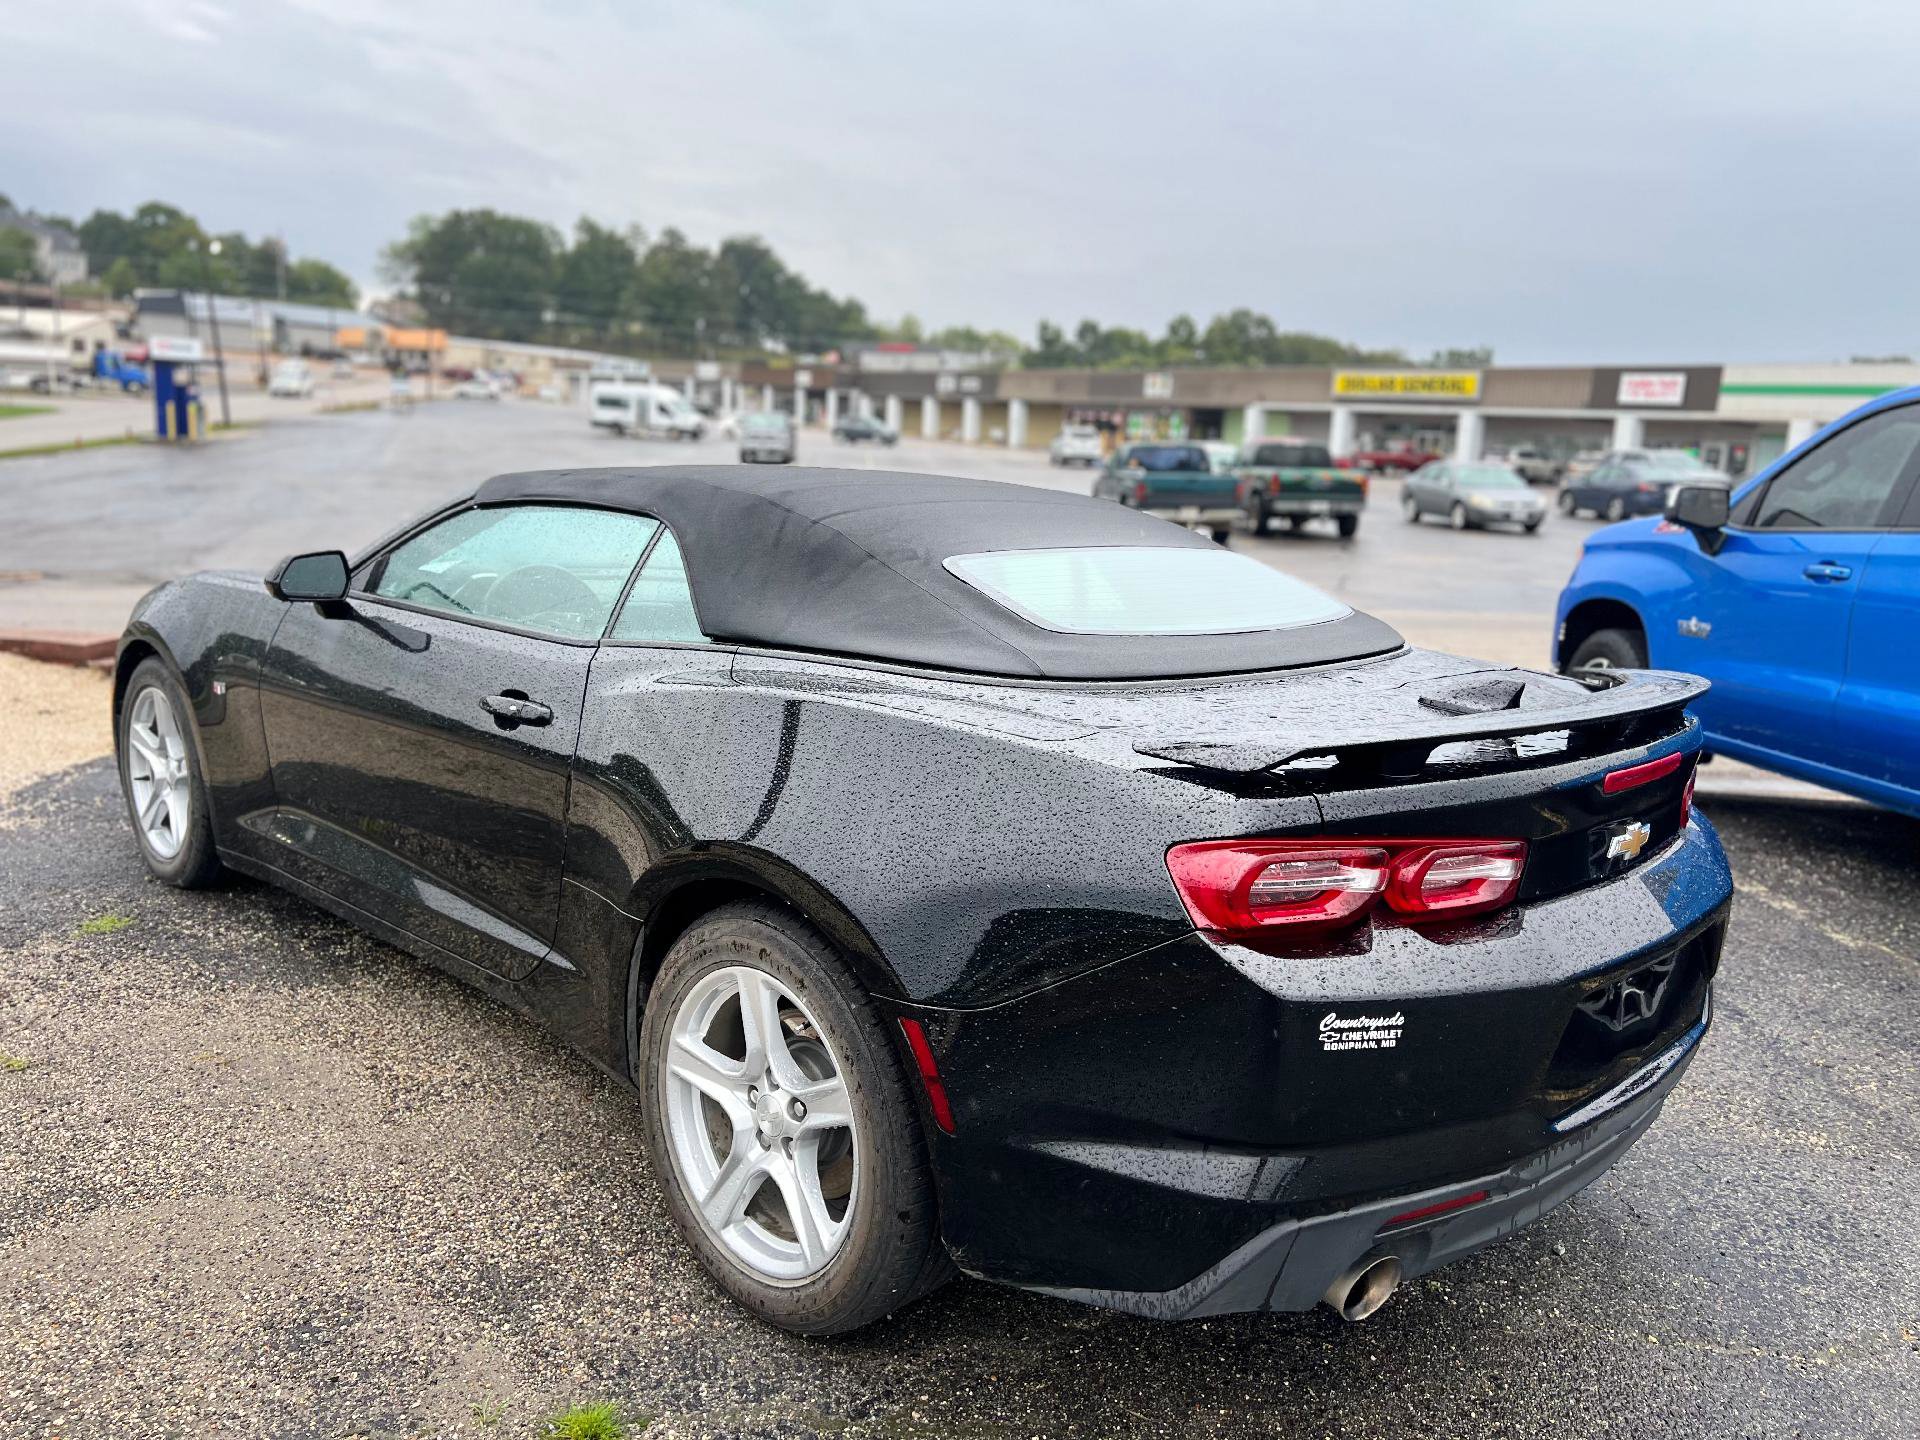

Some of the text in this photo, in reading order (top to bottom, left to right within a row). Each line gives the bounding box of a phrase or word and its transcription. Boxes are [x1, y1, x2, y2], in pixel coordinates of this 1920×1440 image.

[1342, 374, 1466, 394] DOLLAR GENERAL
[1319, 1011, 1405, 1031] Countryside
[1341, 1029, 1403, 1041] CHEVROLET
[1380, 1039, 1397, 1048] MO
